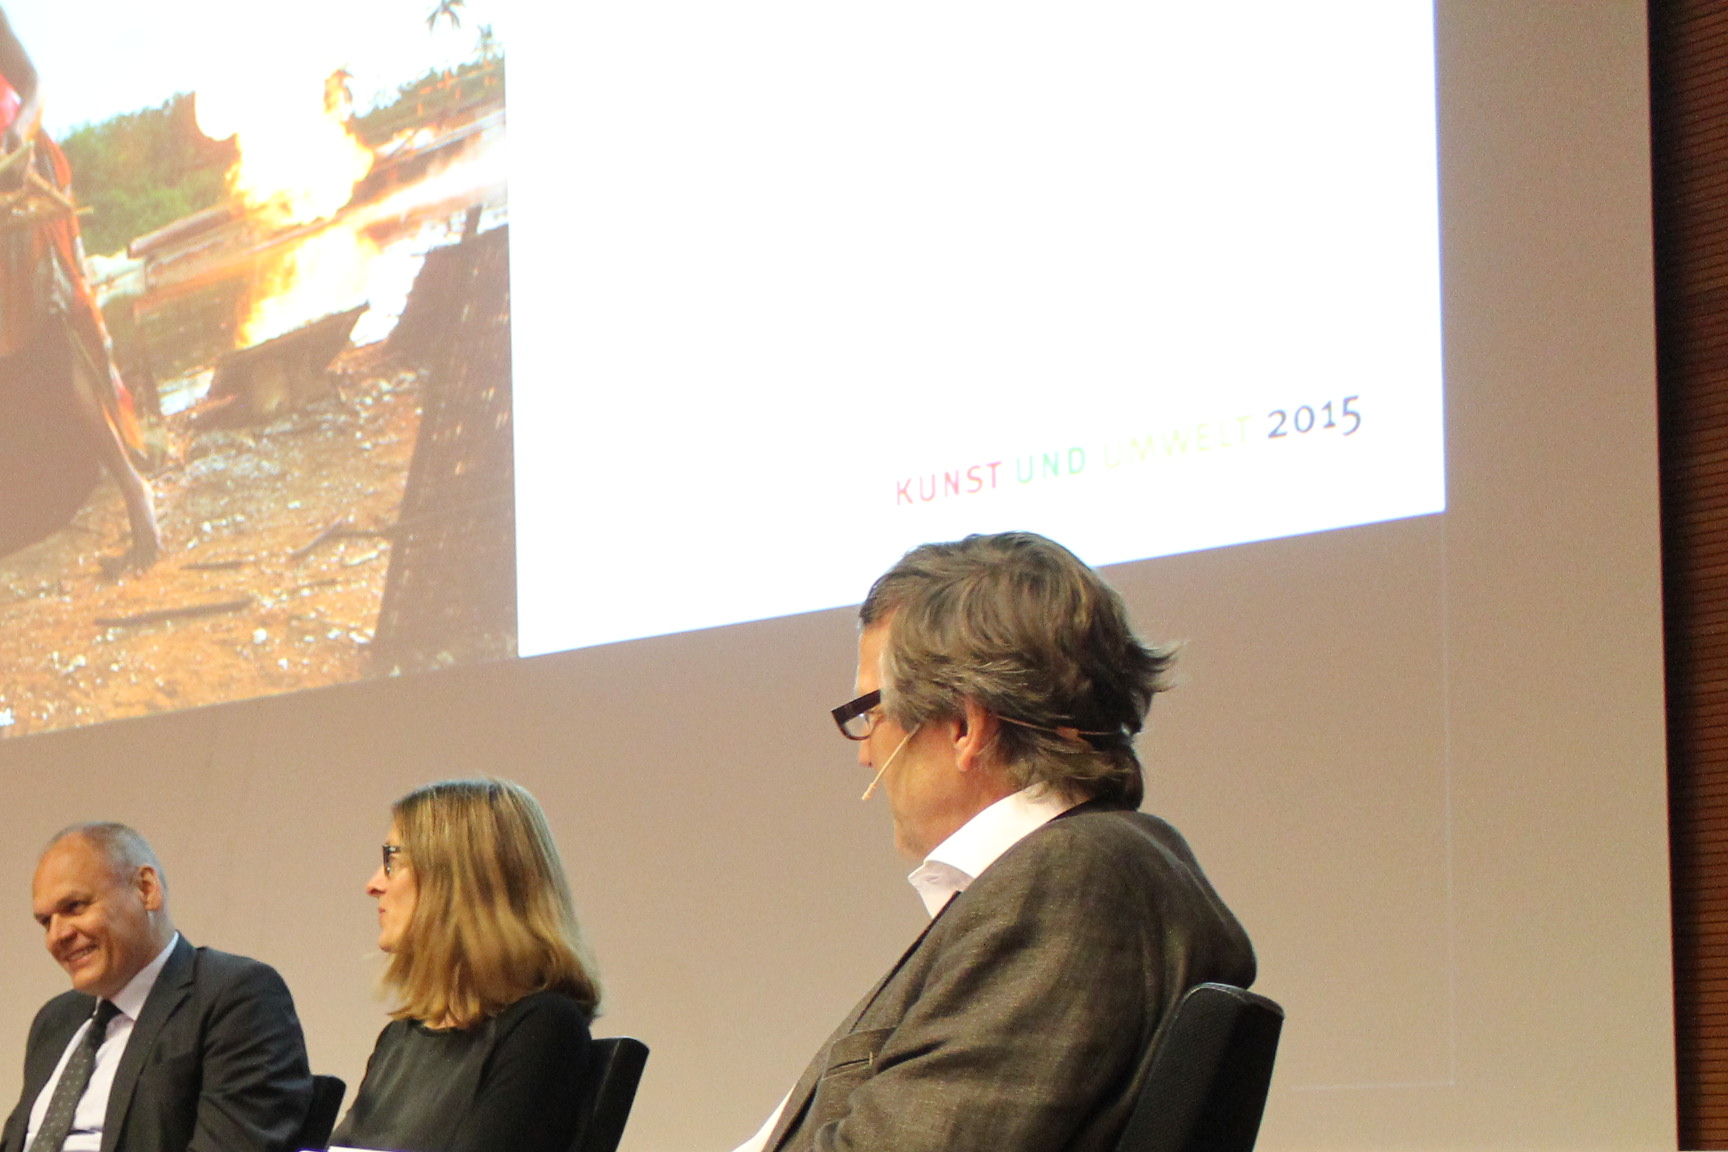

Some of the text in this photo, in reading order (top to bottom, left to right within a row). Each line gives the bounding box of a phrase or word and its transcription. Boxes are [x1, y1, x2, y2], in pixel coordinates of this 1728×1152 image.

[895, 394, 1363, 507] KUNST UND UMWELT 2015
